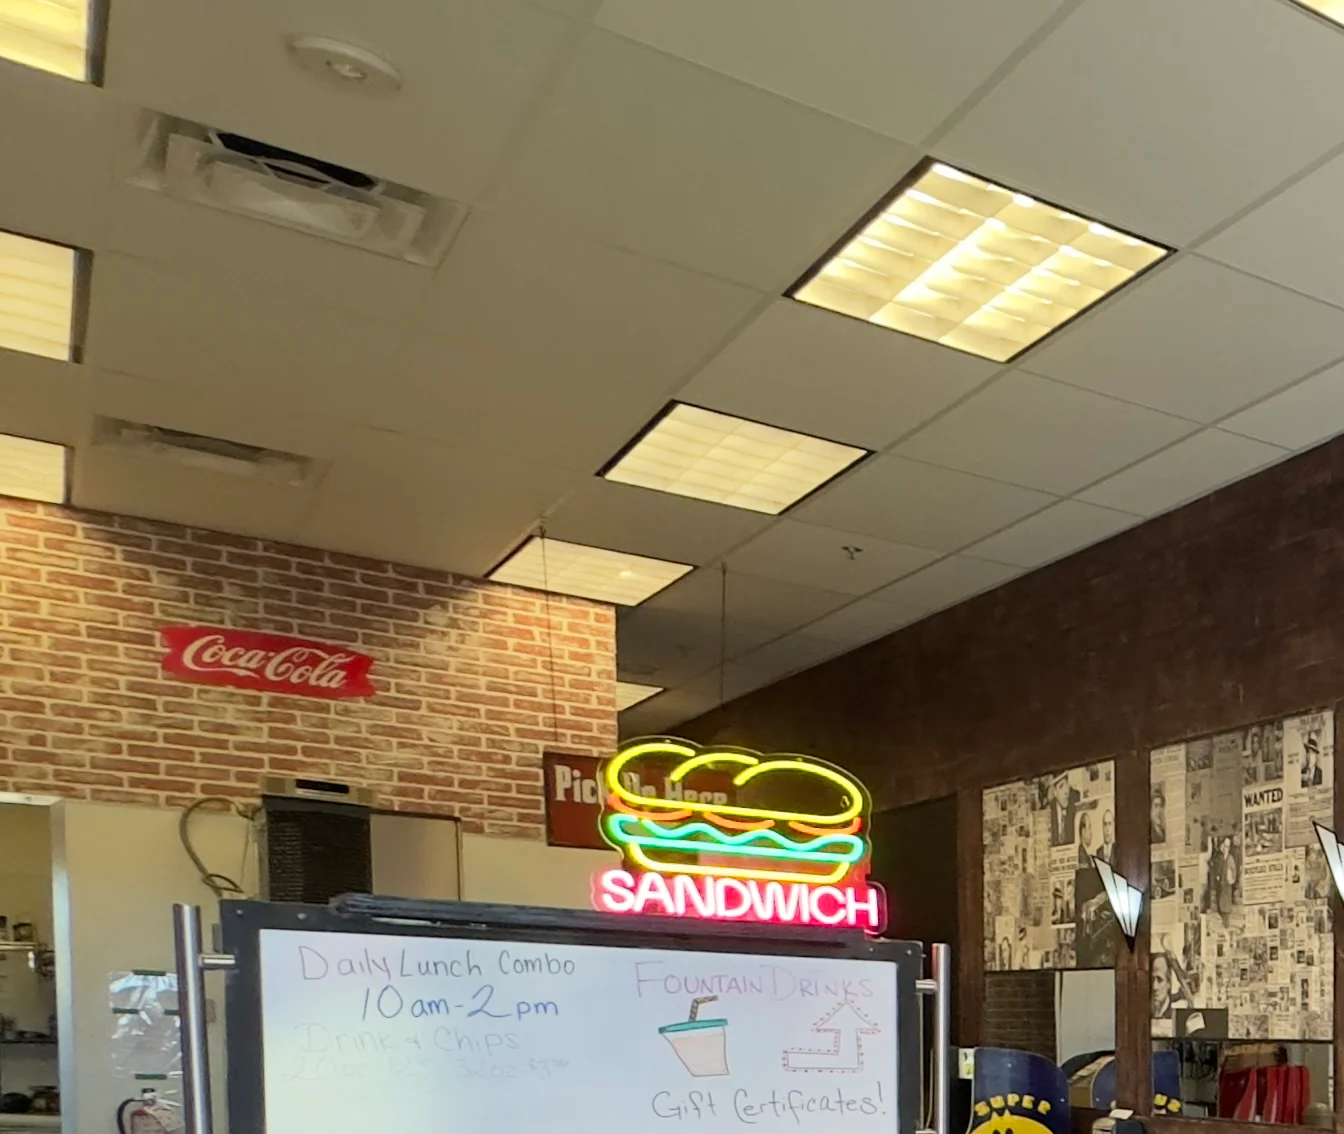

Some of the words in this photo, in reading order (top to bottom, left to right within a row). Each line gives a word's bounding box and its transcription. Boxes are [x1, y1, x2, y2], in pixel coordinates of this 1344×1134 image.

[182, 634, 355, 688] Coca-Cola
[554, 765, 607, 804] Pic
[1244, 787, 1284, 809] WANTED
[601, 869, 880, 927] SANDWICH
[297, 945, 394, 982] Daily
[398, 946, 483, 979] Lunch
[498, 949, 577, 978] Combo
[293, 1022, 395, 1054] Drink
[433, 1026, 520, 1057] Chips
[652, 1089, 717, 1121] Gift
[733, 1081, 888, 1125] Certificates!
[974, 1092, 1051, 1117] SUPER
